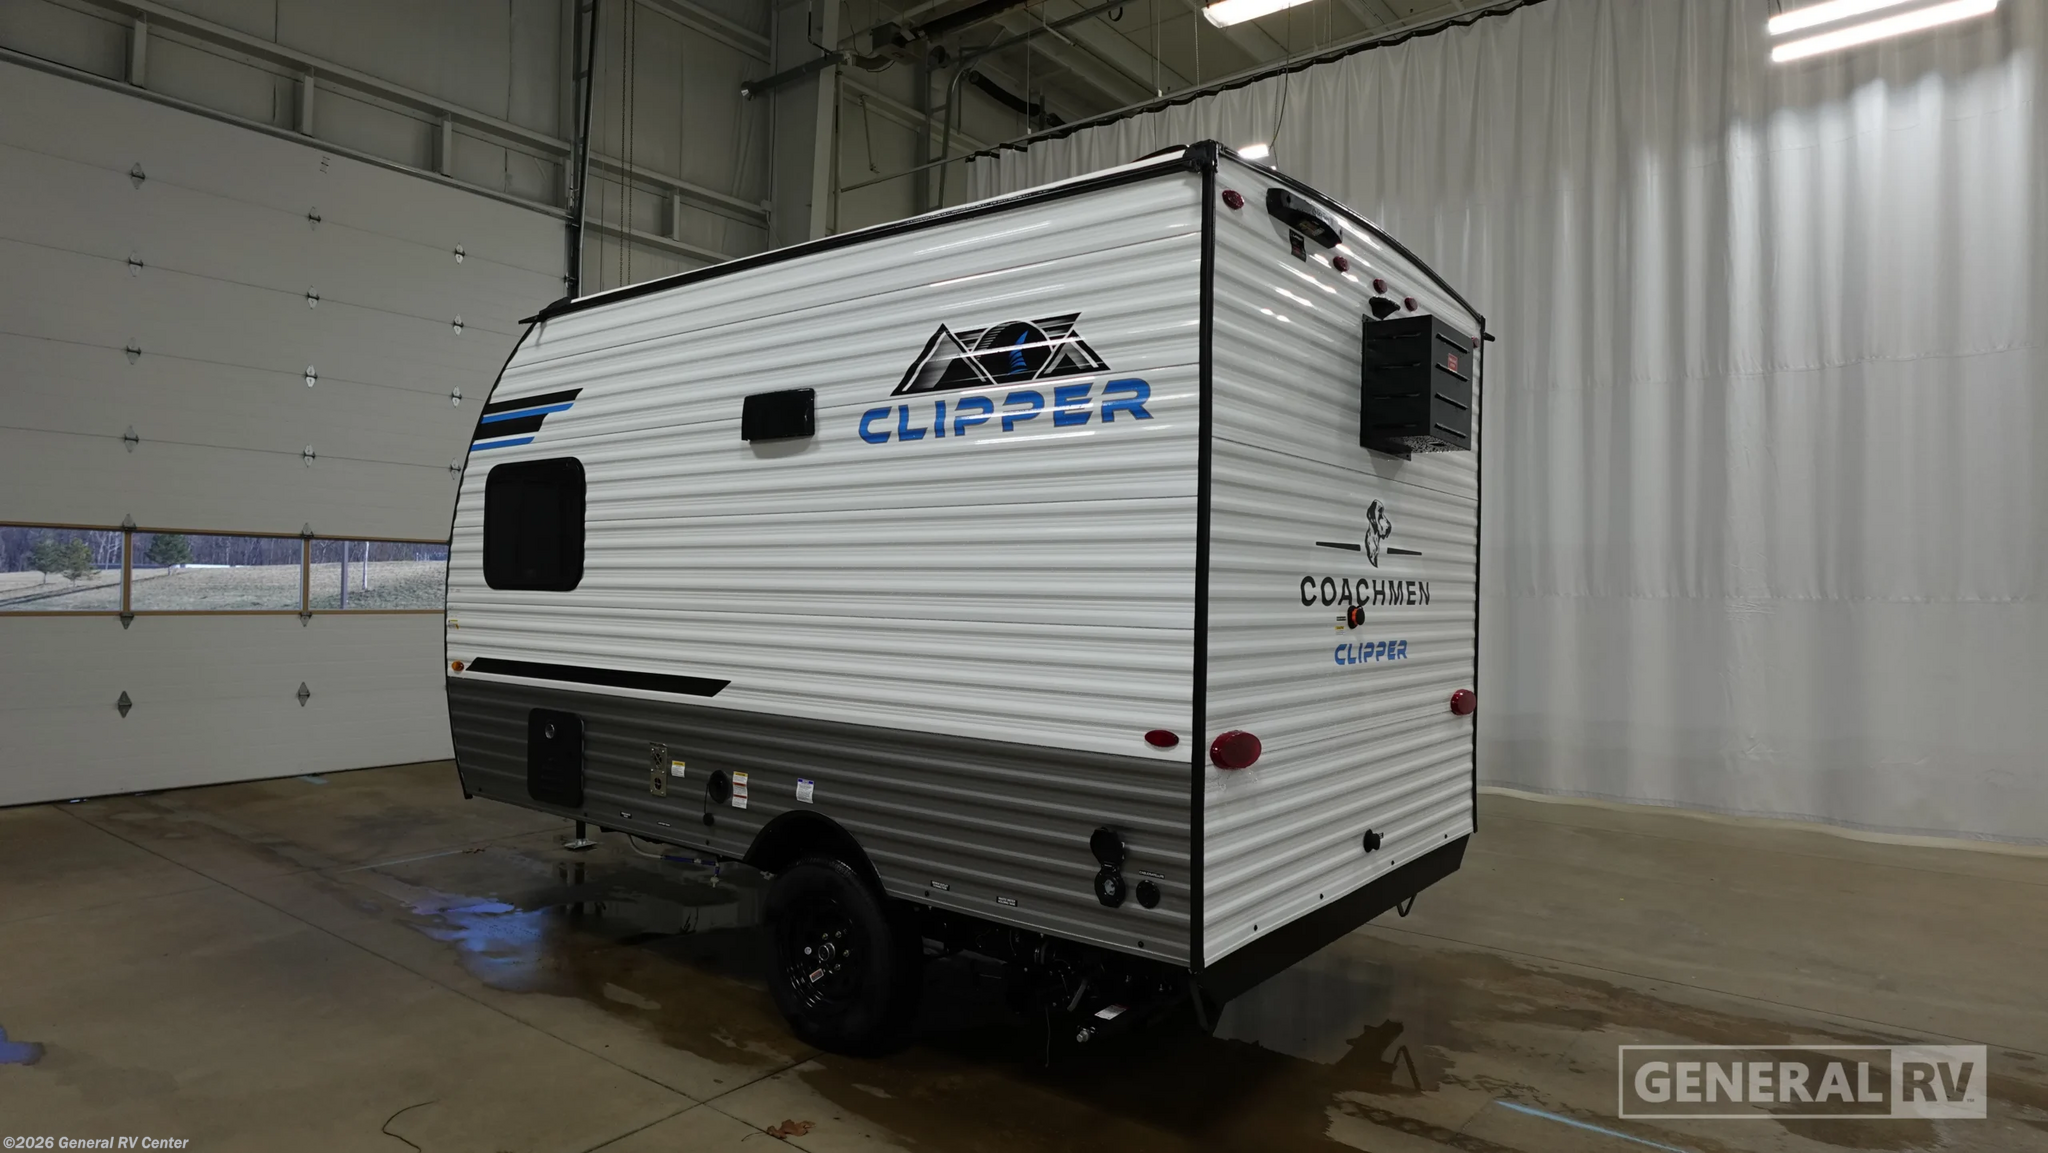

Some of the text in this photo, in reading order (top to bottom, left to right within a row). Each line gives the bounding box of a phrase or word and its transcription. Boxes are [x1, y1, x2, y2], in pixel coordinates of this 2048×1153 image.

[858, 377, 1154, 444] CLIPPER
[1300, 575, 1430, 606] COACHMEN
[1334, 639, 1408, 666] CLIPPER
